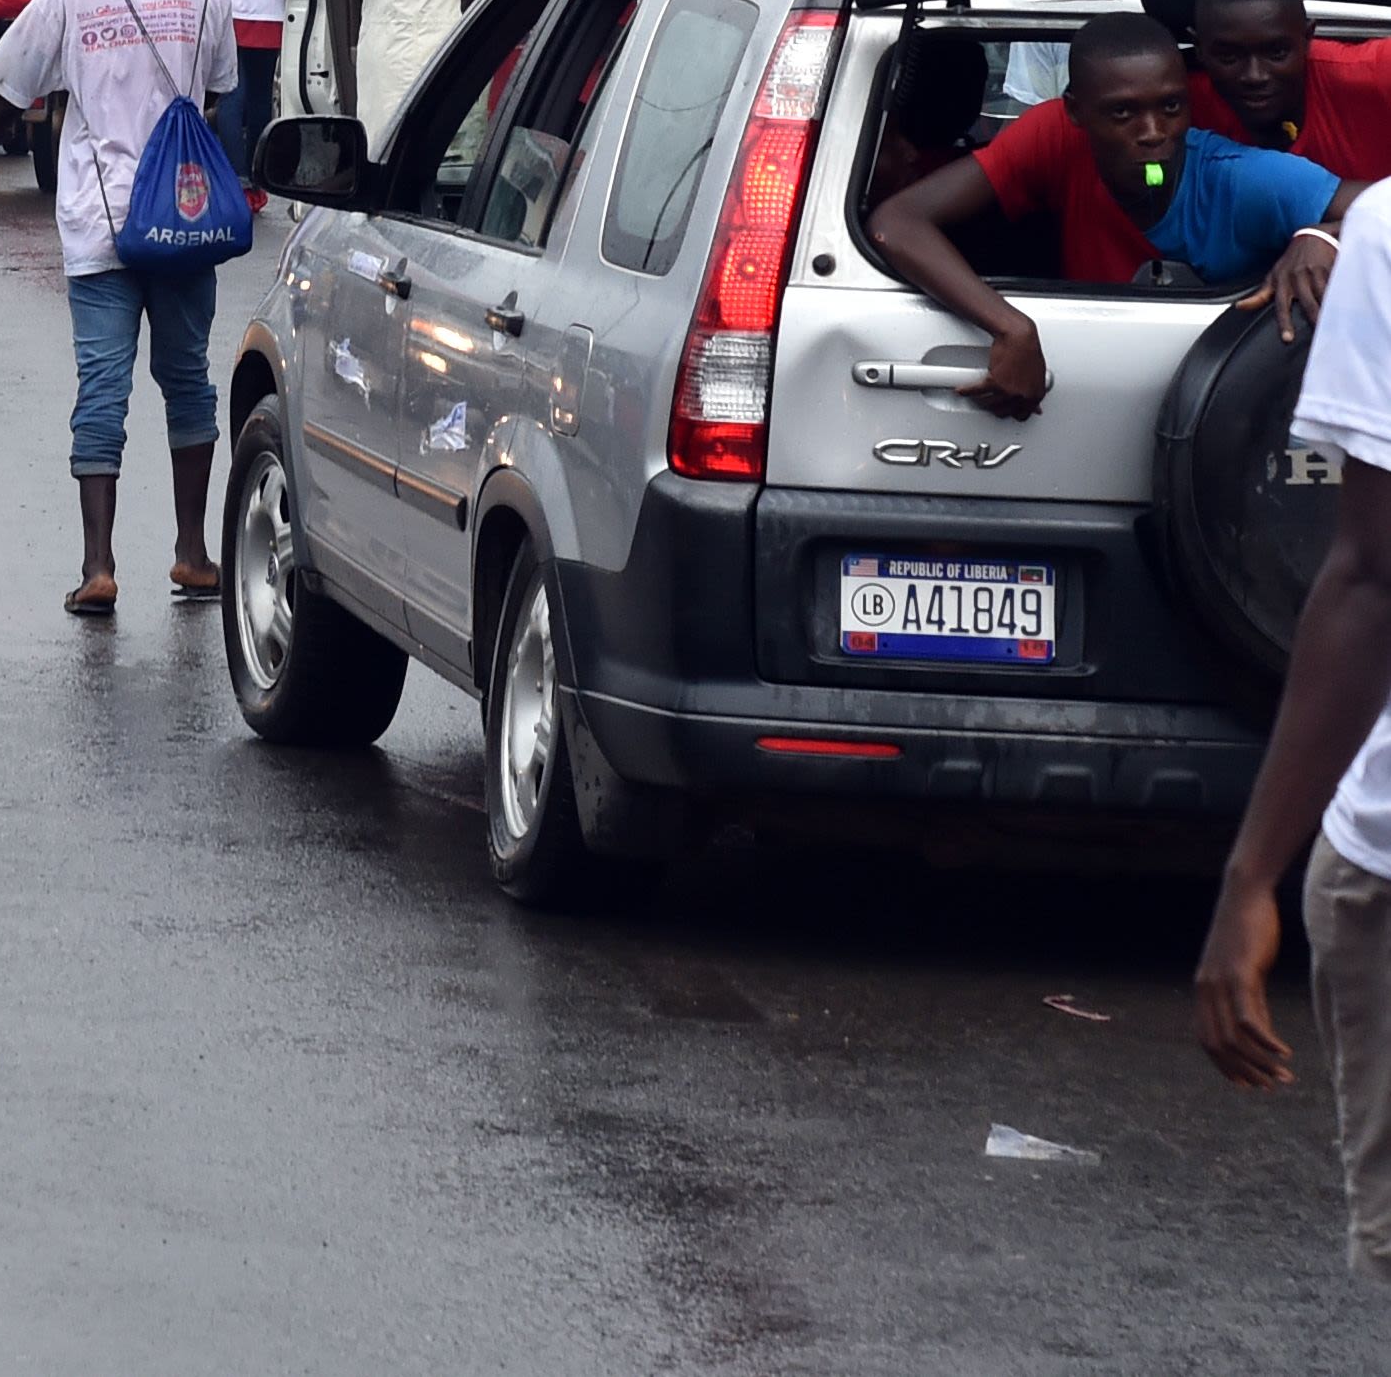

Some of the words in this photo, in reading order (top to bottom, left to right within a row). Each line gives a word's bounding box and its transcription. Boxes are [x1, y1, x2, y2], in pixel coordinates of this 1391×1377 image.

[85, 42, 106, 53] REAL
[144, 226, 236, 246] ARSENAL
[873, 438, 1023, 469] CR-V
[1284, 449, 1344, 485] H
[889, 560, 944, 578] REPUBLIC
[946, 565, 960, 578] OF
[963, 566, 1008, 581] LIBERIA
[861, 593, 885, 616] LB
[901, 583, 1042, 636] A41849
